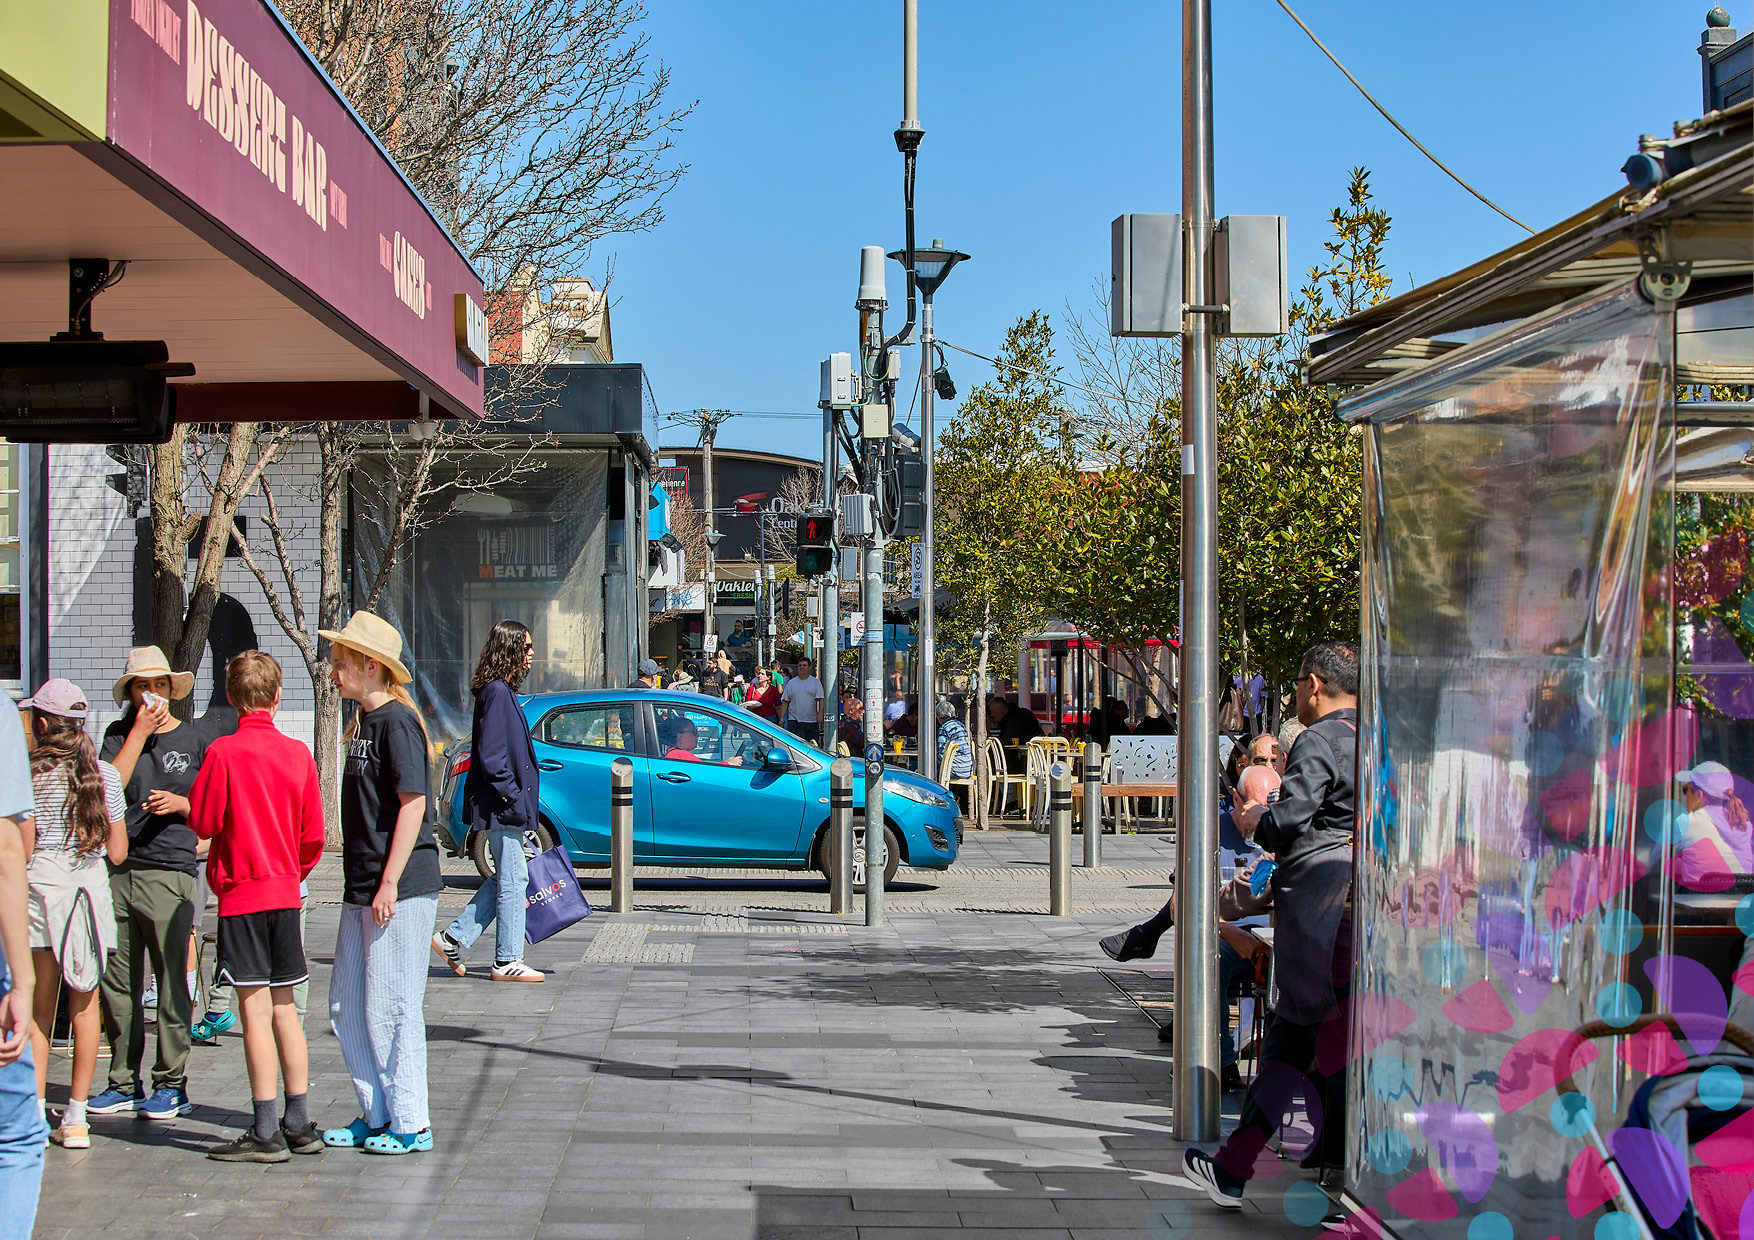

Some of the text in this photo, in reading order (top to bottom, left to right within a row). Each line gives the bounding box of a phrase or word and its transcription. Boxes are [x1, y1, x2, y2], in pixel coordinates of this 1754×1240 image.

[187, 0, 327, 231] DESSERT BAR
[478, 565, 558, 578] MEAT ME
[716, 580, 755, 592] Oaklei
[529, 879, 567, 904] salvos
[541, 892, 563, 906] STORES
